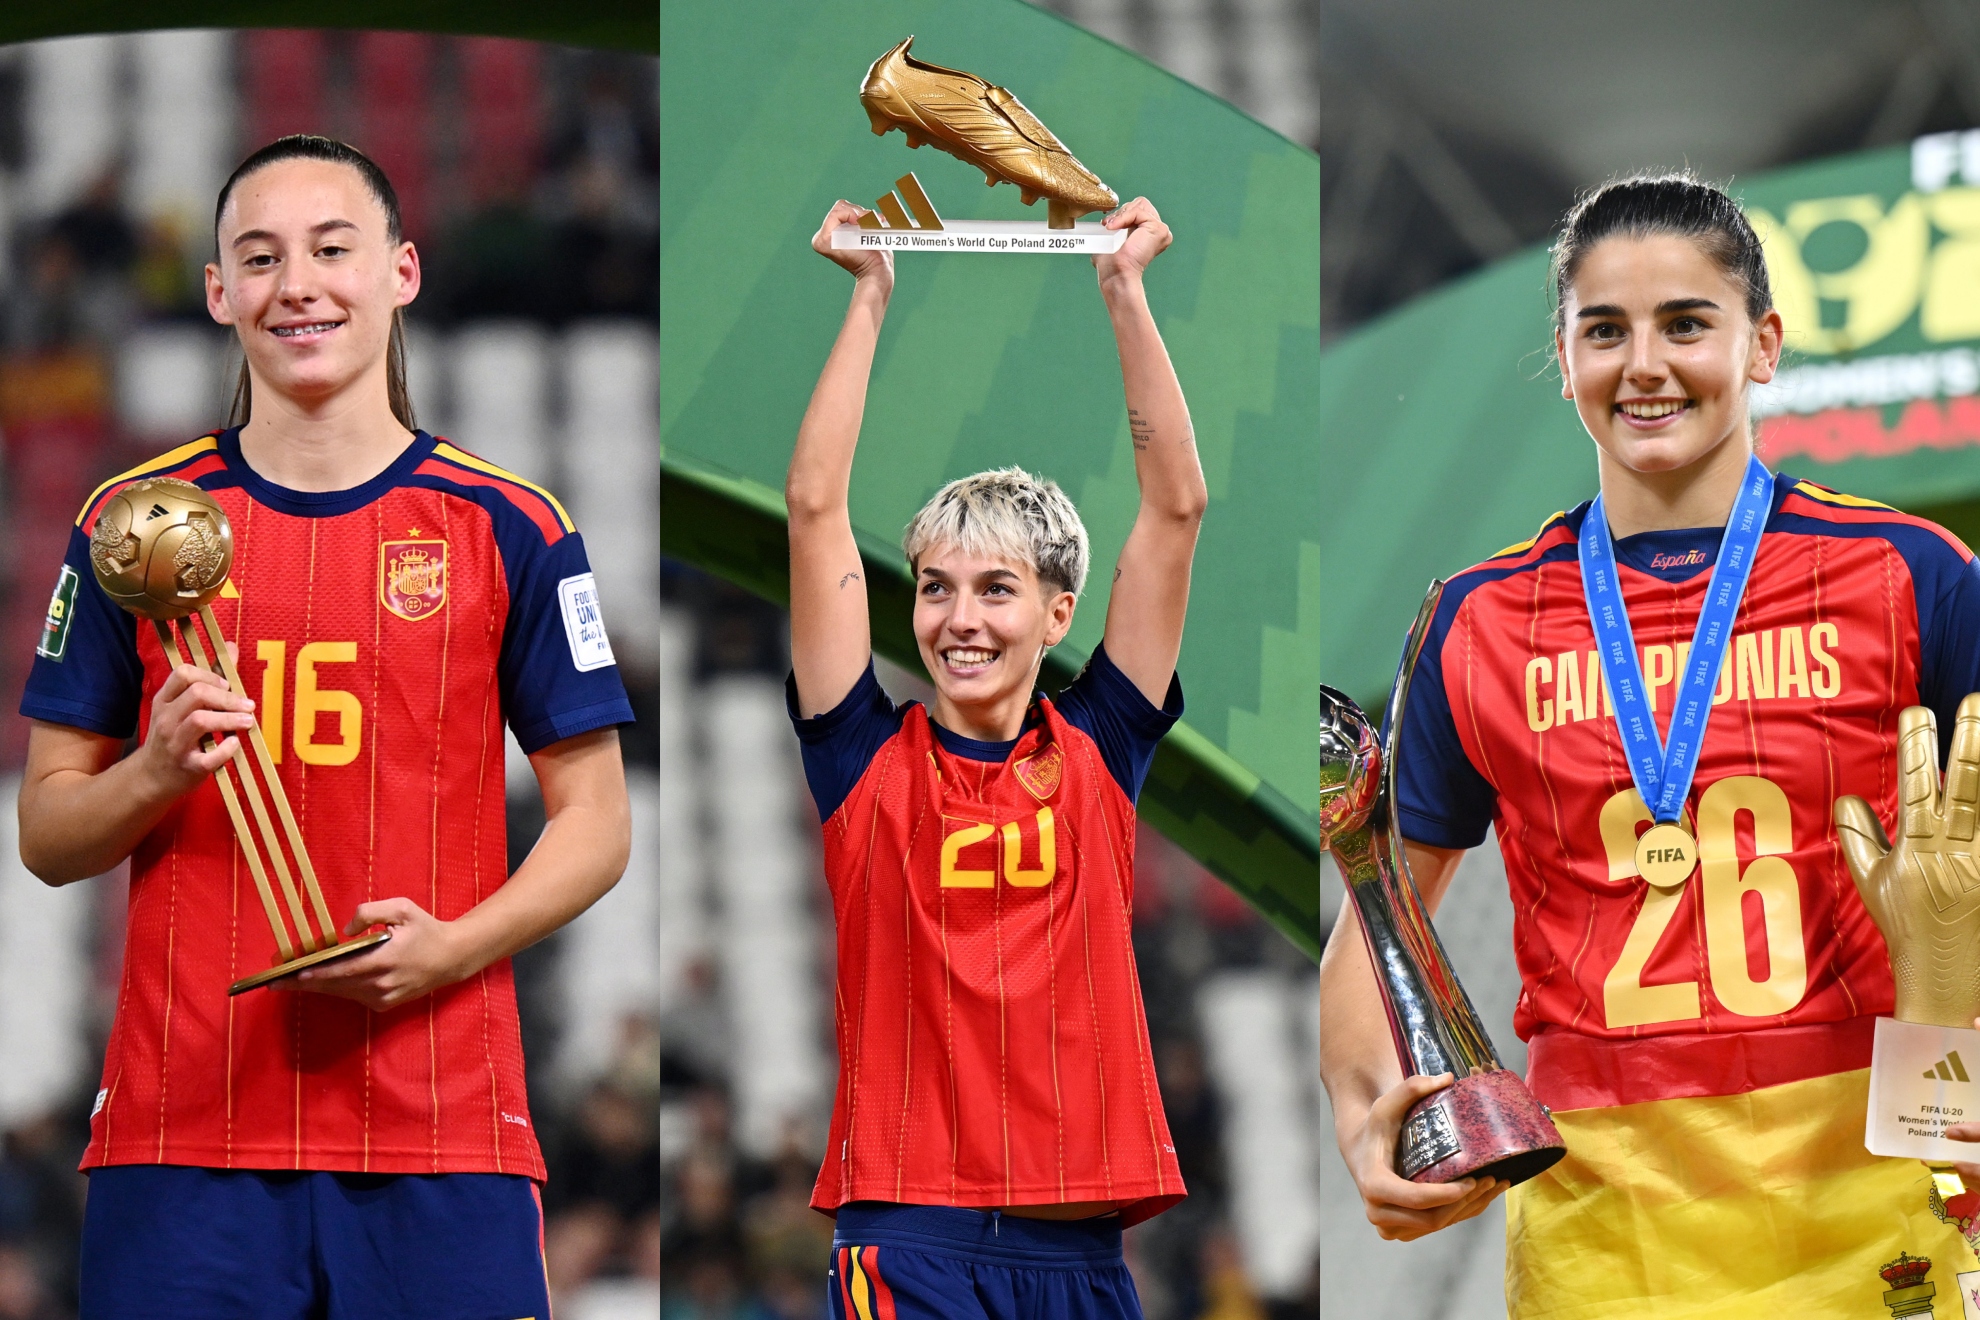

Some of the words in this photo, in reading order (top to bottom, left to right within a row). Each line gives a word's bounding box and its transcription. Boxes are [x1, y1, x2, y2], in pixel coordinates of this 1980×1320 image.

[860, 235, 882, 246] FIFA
[885, 236, 909, 247] U-20
[911, 236, 955, 248] Women's
[957, 237, 985, 248] World
[988, 237, 1008, 250] Cup
[1011, 238, 1045, 248] Poland
[1650, 549, 1707, 571] España
[257, 640, 363, 766] 16
[940, 806, 1057, 888] 20
[1646, 847, 1686, 864] FIFA
[1598, 775, 1808, 1030] 26
[1921, 1105, 1940, 1114] FIFA
[1942, 1107, 1963, 1116] U-20
[1898, 1115, 1938, 1126] Women's
[1908, 1128, 1938, 1138] Poland
